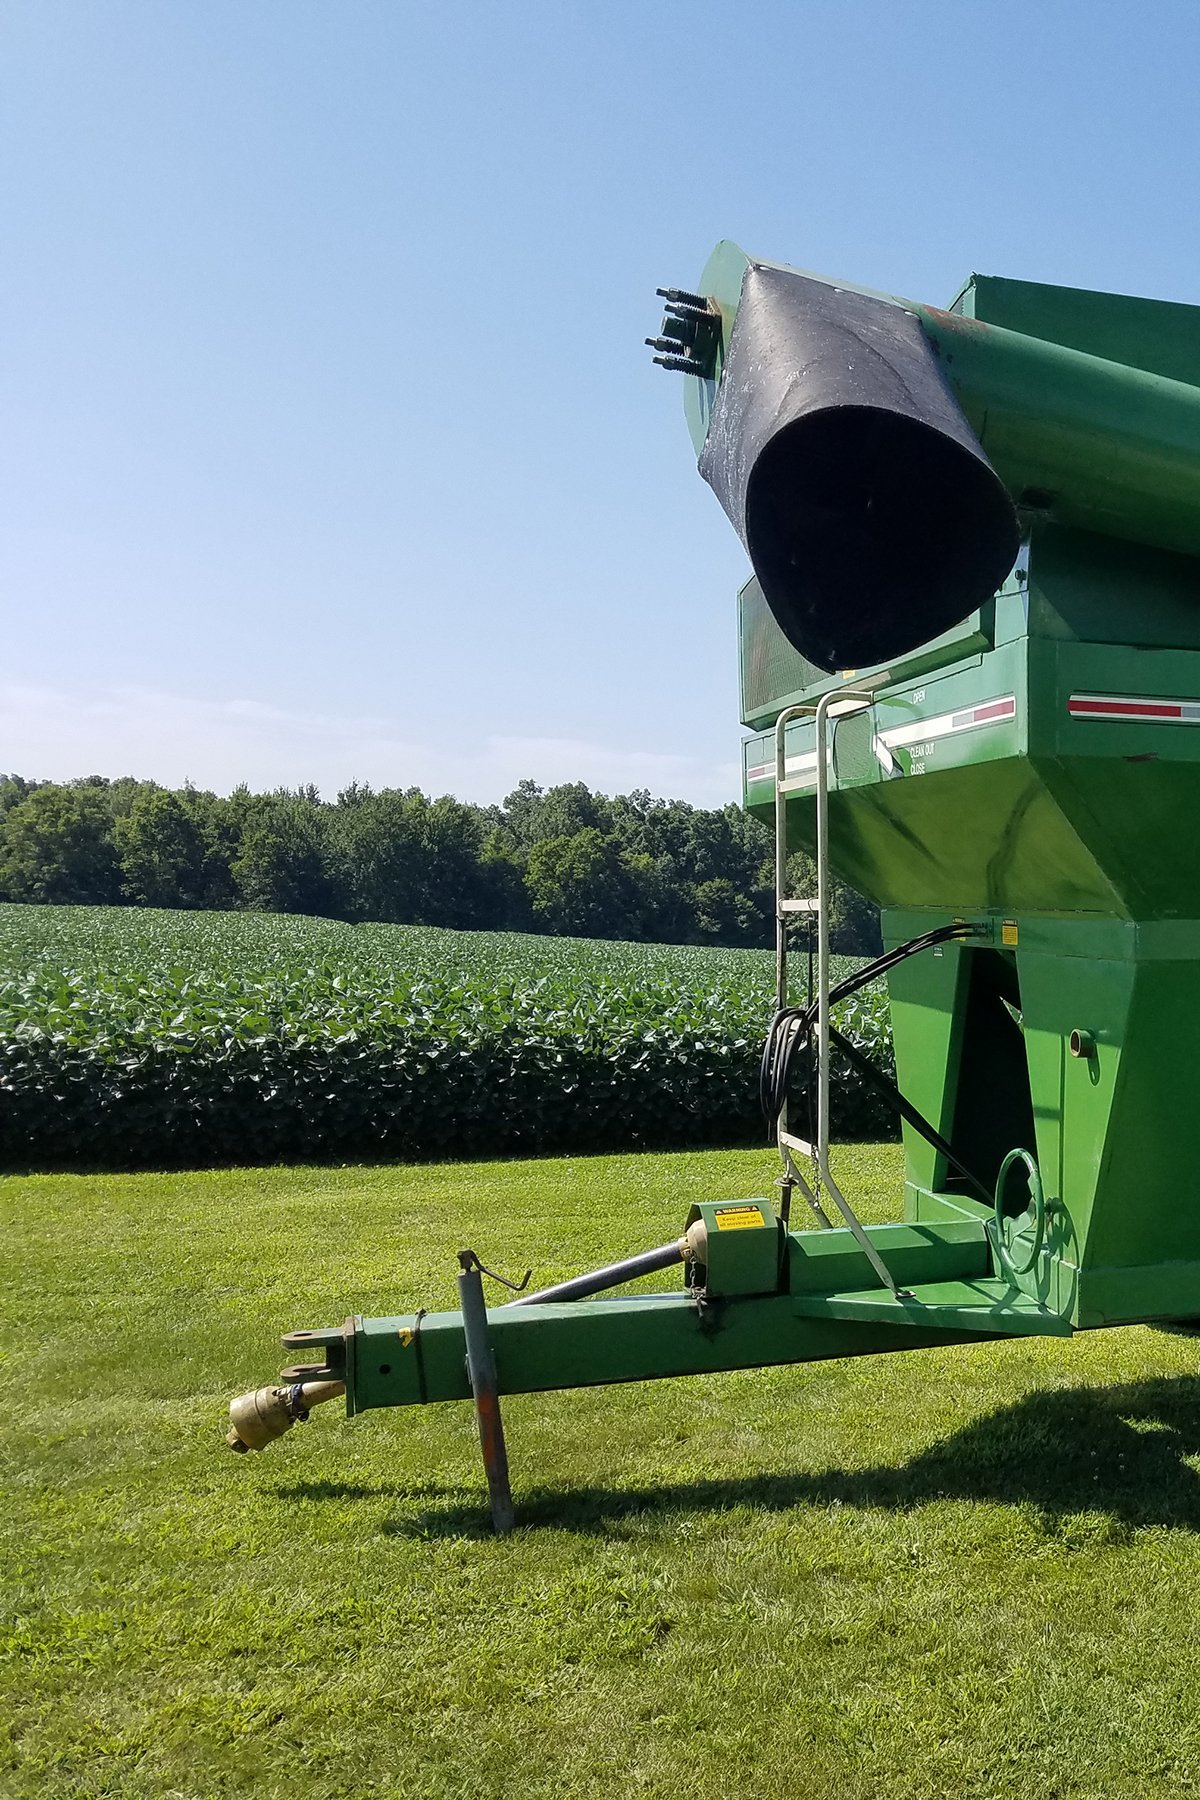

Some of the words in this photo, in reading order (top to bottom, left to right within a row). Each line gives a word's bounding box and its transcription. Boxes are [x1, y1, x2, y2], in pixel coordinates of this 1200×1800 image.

[913, 691, 926, 704] OPEN
[911, 746, 925, 758] CLEAN
[925, 744, 934, 755] OUT
[911, 764, 925, 775] CLOSE
